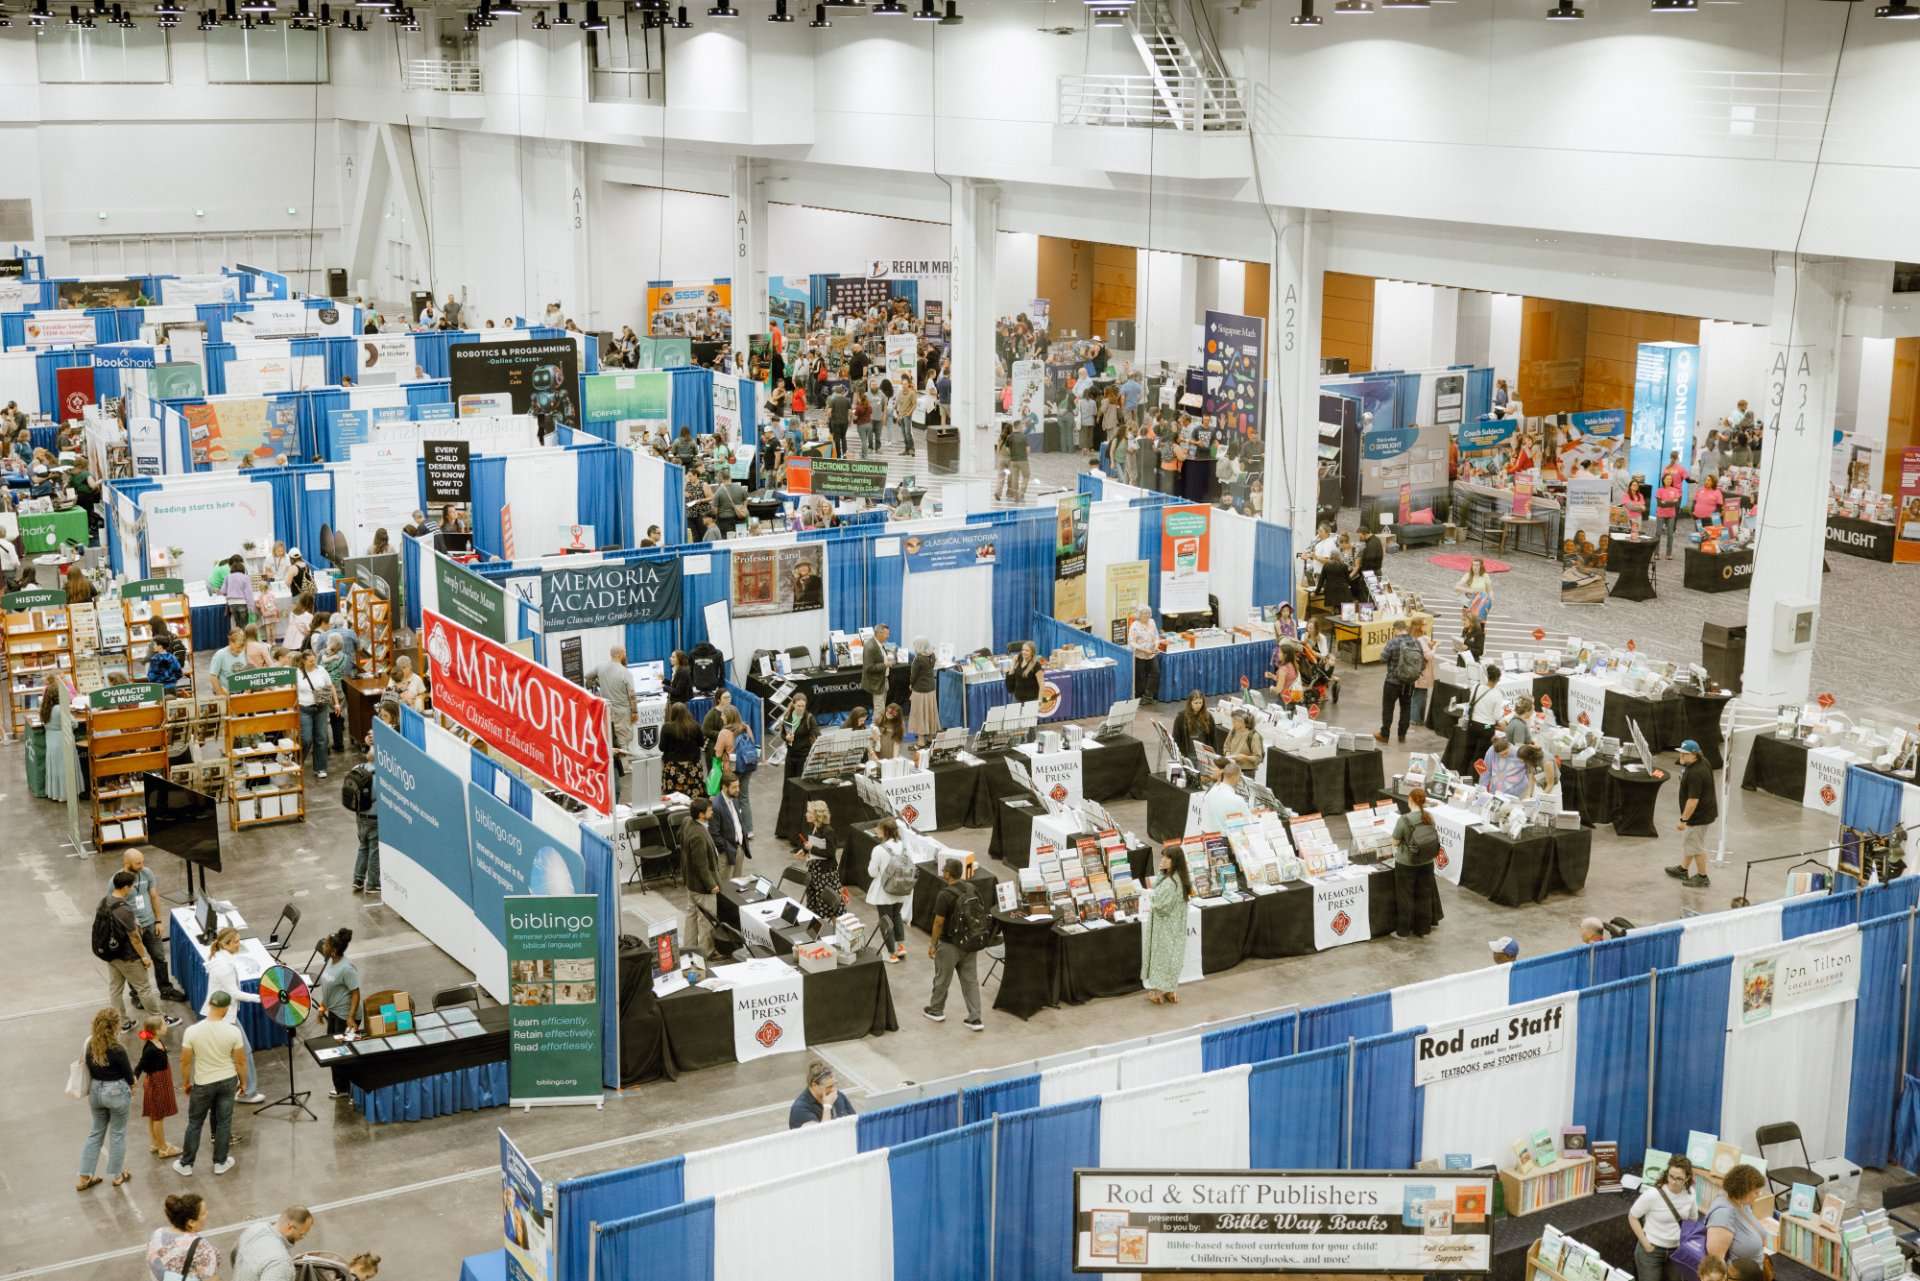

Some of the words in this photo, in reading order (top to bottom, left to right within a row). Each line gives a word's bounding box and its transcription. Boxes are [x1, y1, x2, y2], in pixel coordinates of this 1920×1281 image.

[573, 187, 583, 230] A13
[738, 210, 748, 257] A18
[892, 261, 929, 274] REALM
[932, 261, 952, 274] MA
[1284, 284, 1297, 352] A23
[456, 350, 499, 358] ROBOTICS
[509, 345, 571, 356] PROGRAMMING
[96, 357, 154, 369] BookShark
[1770, 351, 1787, 432] A34
[428, 463, 466, 471] DESERVES
[812, 461, 849, 472] ELECTRONICS
[851, 464, 889, 474] CURRICULUM
[436, 488, 460, 496] WRITE
[153, 505, 186, 514] Reading
[190, 503, 214, 511] starts
[216, 501, 234, 509] here
[735, 549, 779, 564] Professor
[780, 551, 801, 561] Carol
[1733, 565, 1753, 576] SON
[551, 567, 661, 592] MEMORIA
[141, 584, 165, 593] BIBLE
[16, 594, 52, 605] HISTORY
[550, 586, 659, 613] ACADEMY
[594, 613, 606, 624] for
[607, 609, 632, 621] Grades
[1368, 627, 1397, 646] Bibli
[235, 675, 268, 684] CHARLOTTE
[270, 670, 290, 679] MASON
[250, 677, 276, 686] HELPS
[102, 687, 152, 698] CHARACTER
[814, 681, 848, 694] PROFESSOR
[849, 679, 862, 690] CA
[118, 694, 145, 703] MUSIC
[456, 632, 607, 766] MEMORIA
[467, 705, 503, 739] Christian
[506, 731, 545, 764] Education
[377, 744, 415, 791] biblingo
[553, 743, 607, 804] PRESS
[1035, 762, 1079, 775] MEMORIA
[1811, 760, 1849, 777] MEMORI
[1045, 773, 1071, 783] PRESS
[885, 782, 932, 797] MEMORIA
[896, 793, 923, 805] PRESS
[476, 806, 522, 856] biblingo.org
[1317, 885, 1365, 902] MEMORIA
[1328, 898, 1355, 911] PRESS
[510, 913, 593, 932] biblingo
[548, 941, 582, 951] languages
[1814, 953, 1852, 972] Tilton
[738, 991, 799, 1011] MEMORIA
[752, 1006, 787, 1020] PRESS
[514, 1018, 540, 1027] Learn
[542, 1016, 588, 1028] efficiently.
[514, 1030, 543, 1040] Retain
[1420, 1028, 1464, 1061] Rod
[1471, 1028, 1499, 1049] and
[1508, 1006, 1562, 1041] Staff
[514, 1043, 539, 1052] Read
[1441, 1062, 1481, 1080] TEXTBOOKS
[1483, 1060, 1497, 1069] and
[1498, 1047, 1541, 1066] STORYBOOKS
[536, 1078, 577, 1088] biblingo.org
[1107, 1184, 1153, 1204] Rod
[1163, 1185, 1181, 1204] &
[1193, 1184, 1250, 1205] Staff
[1257, 1184, 1378, 1206] Publishers
[1149, 1215, 1189, 1224] presented
[1216, 1213, 1269, 1231] Bible
[1275, 1213, 1321, 1234] Way
[1328, 1214, 1388, 1232] Books
[1189, 1223, 1201, 1232] by:
[1167, 1241, 1222, 1250] Bible-based
[1225, 1241, 1257, 1250] school
[1259, 1241, 1310, 1251] curriculum
[1312, 1241, 1326, 1250] for
[1327, 1243, 1349, 1253] your
[1352, 1242, 1378, 1250] child!
[1440, 1243, 1475, 1252] Curriculum
[1190, 1254, 1238, 1263] Children's
[1303, 1254, 1321, 1263] and
[1323, 1254, 1350, 1263] more!
[1434, 1254, 1463, 1263] Support
